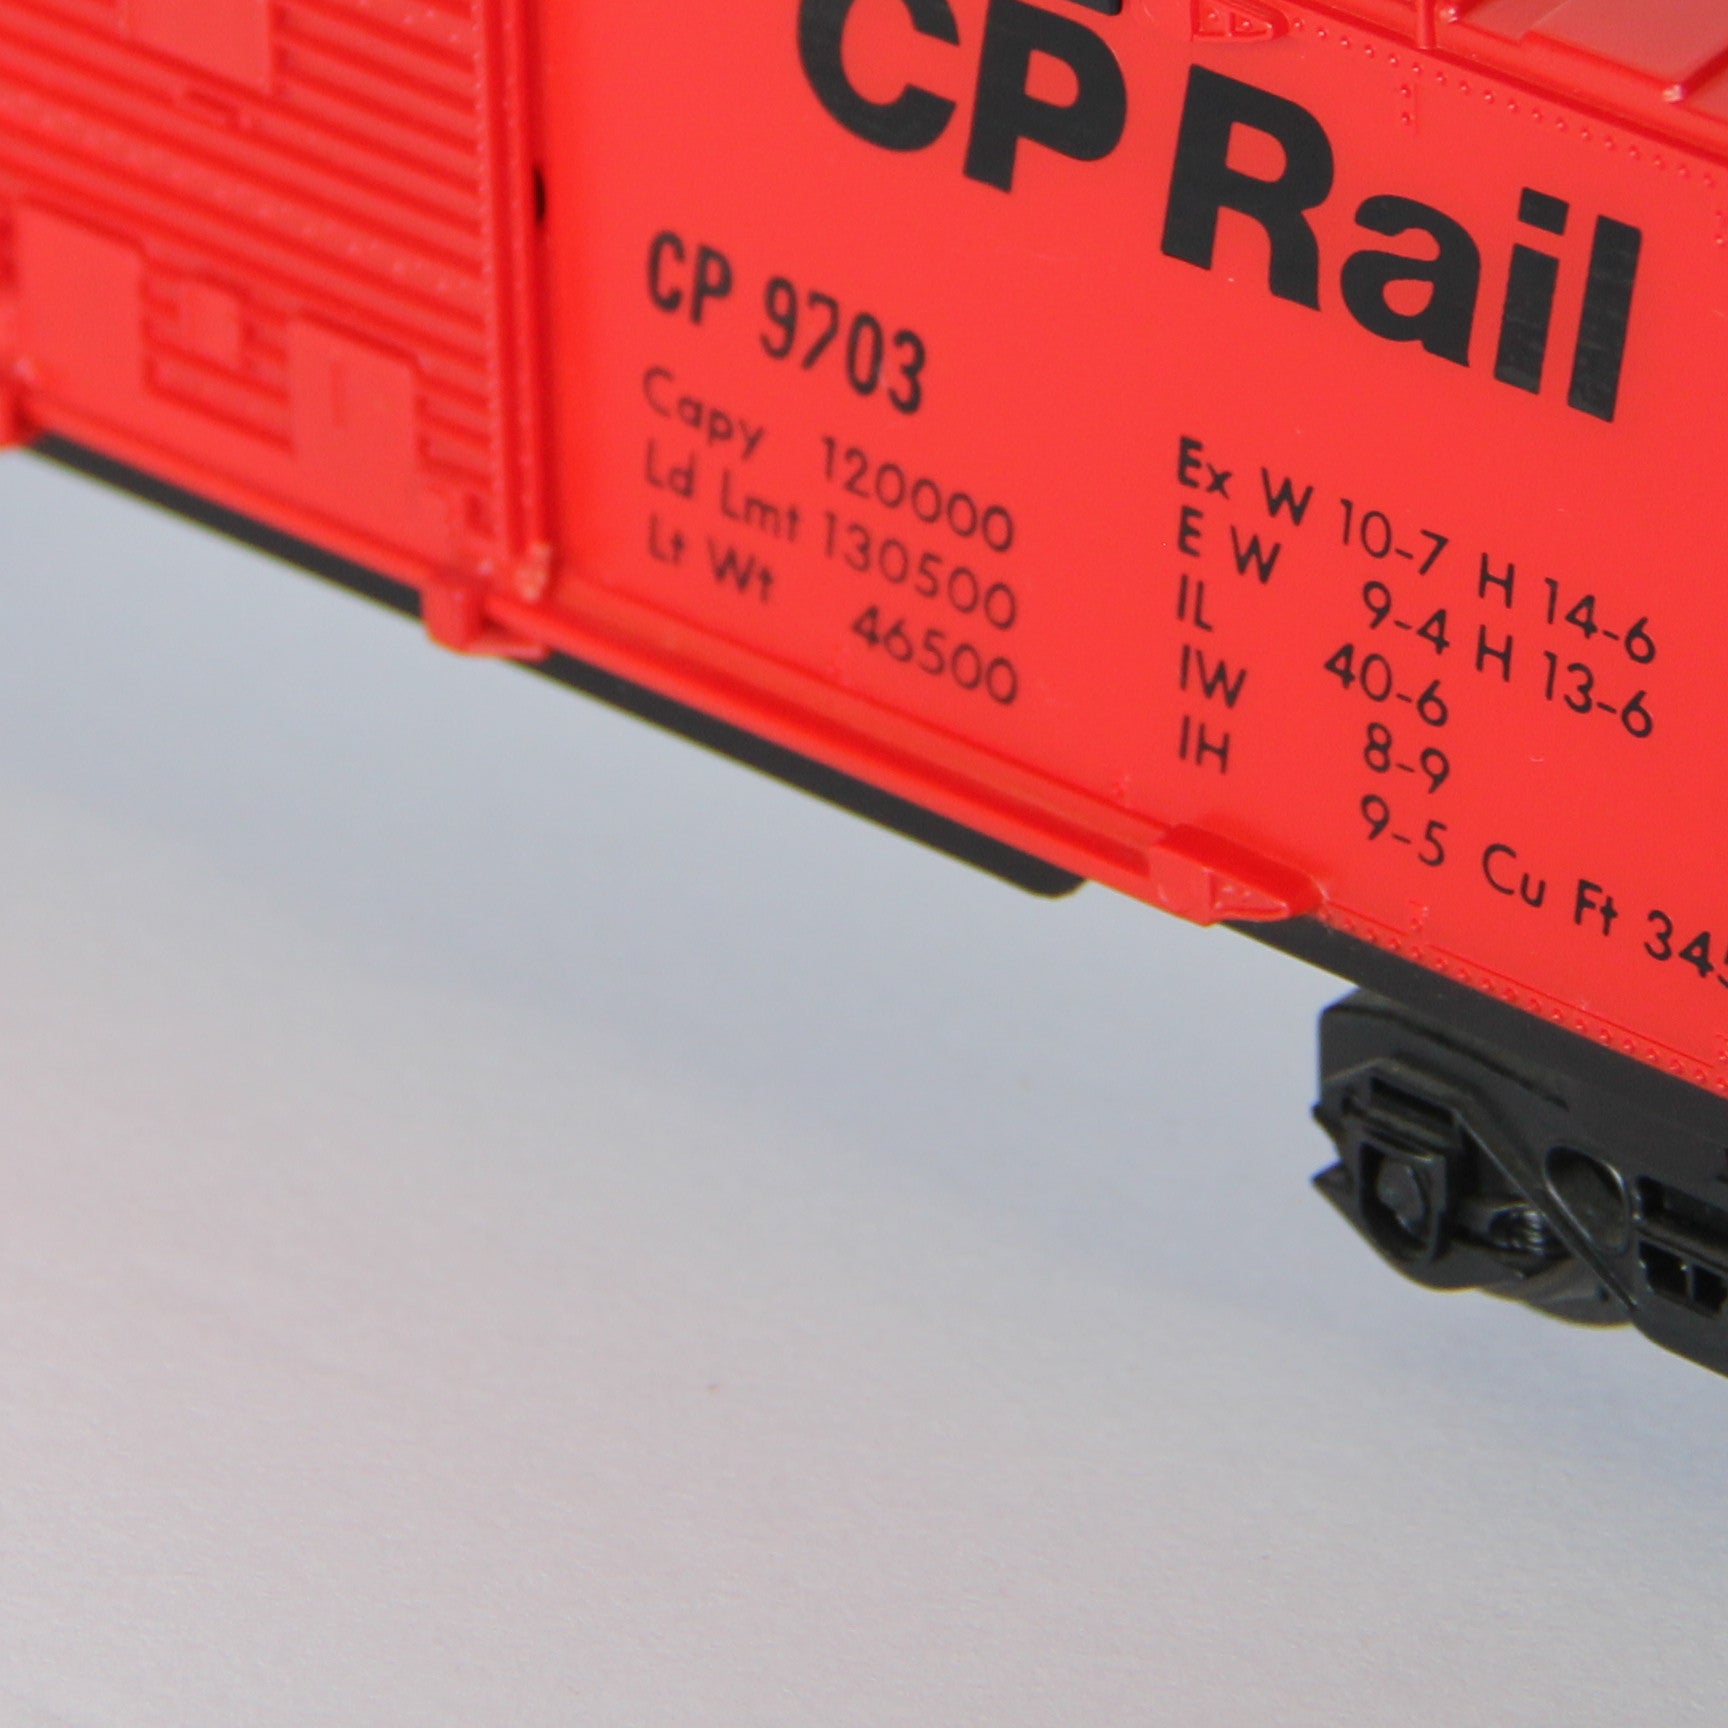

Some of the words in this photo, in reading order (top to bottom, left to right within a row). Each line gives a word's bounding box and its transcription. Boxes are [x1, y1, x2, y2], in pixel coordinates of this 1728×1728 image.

[646, 229, 735, 326] CP
[759, 274, 928, 417] 9703
[1158, 62, 1645, 425] Rail
[643, 366, 765, 462] Capy
[821, 435, 1016, 553] 120000
[645, 438, 697, 500] Ld
[721, 468, 801, 542] Lmt
[824, 511, 1018, 632] 130500
[1175, 434, 1233, 498] Ex
[1260, 466, 1314, 526] W
[1336, 497, 1450, 577] 10-7
[1476, 551, 1517, 610] H
[1540, 576, 1658, 666] 14-6
[648, 515, 687, 566] Lt
[708, 534, 775, 604] Wt
[851, 604, 1019, 707] 46500
[1175, 573, 1214, 633] IL
[1322, 641, 1451, 729] 40-6
[1176, 504, 1205, 559] E
[1229, 525, 1282, 586] W
[1360, 579, 1452, 656] 9-4
[1474, 623, 1515, 683] H
[1540, 649, 1655, 740] 13-6
[1178, 643, 1249, 710] IW
[1362, 720, 1452, 795] 8-9
[1177, 714, 1232, 774] IH
[1359, 792, 1448, 869] 9-5
[1480, 841, 1548, 909] Cu
[1572, 877, 1619, 938] Ft
